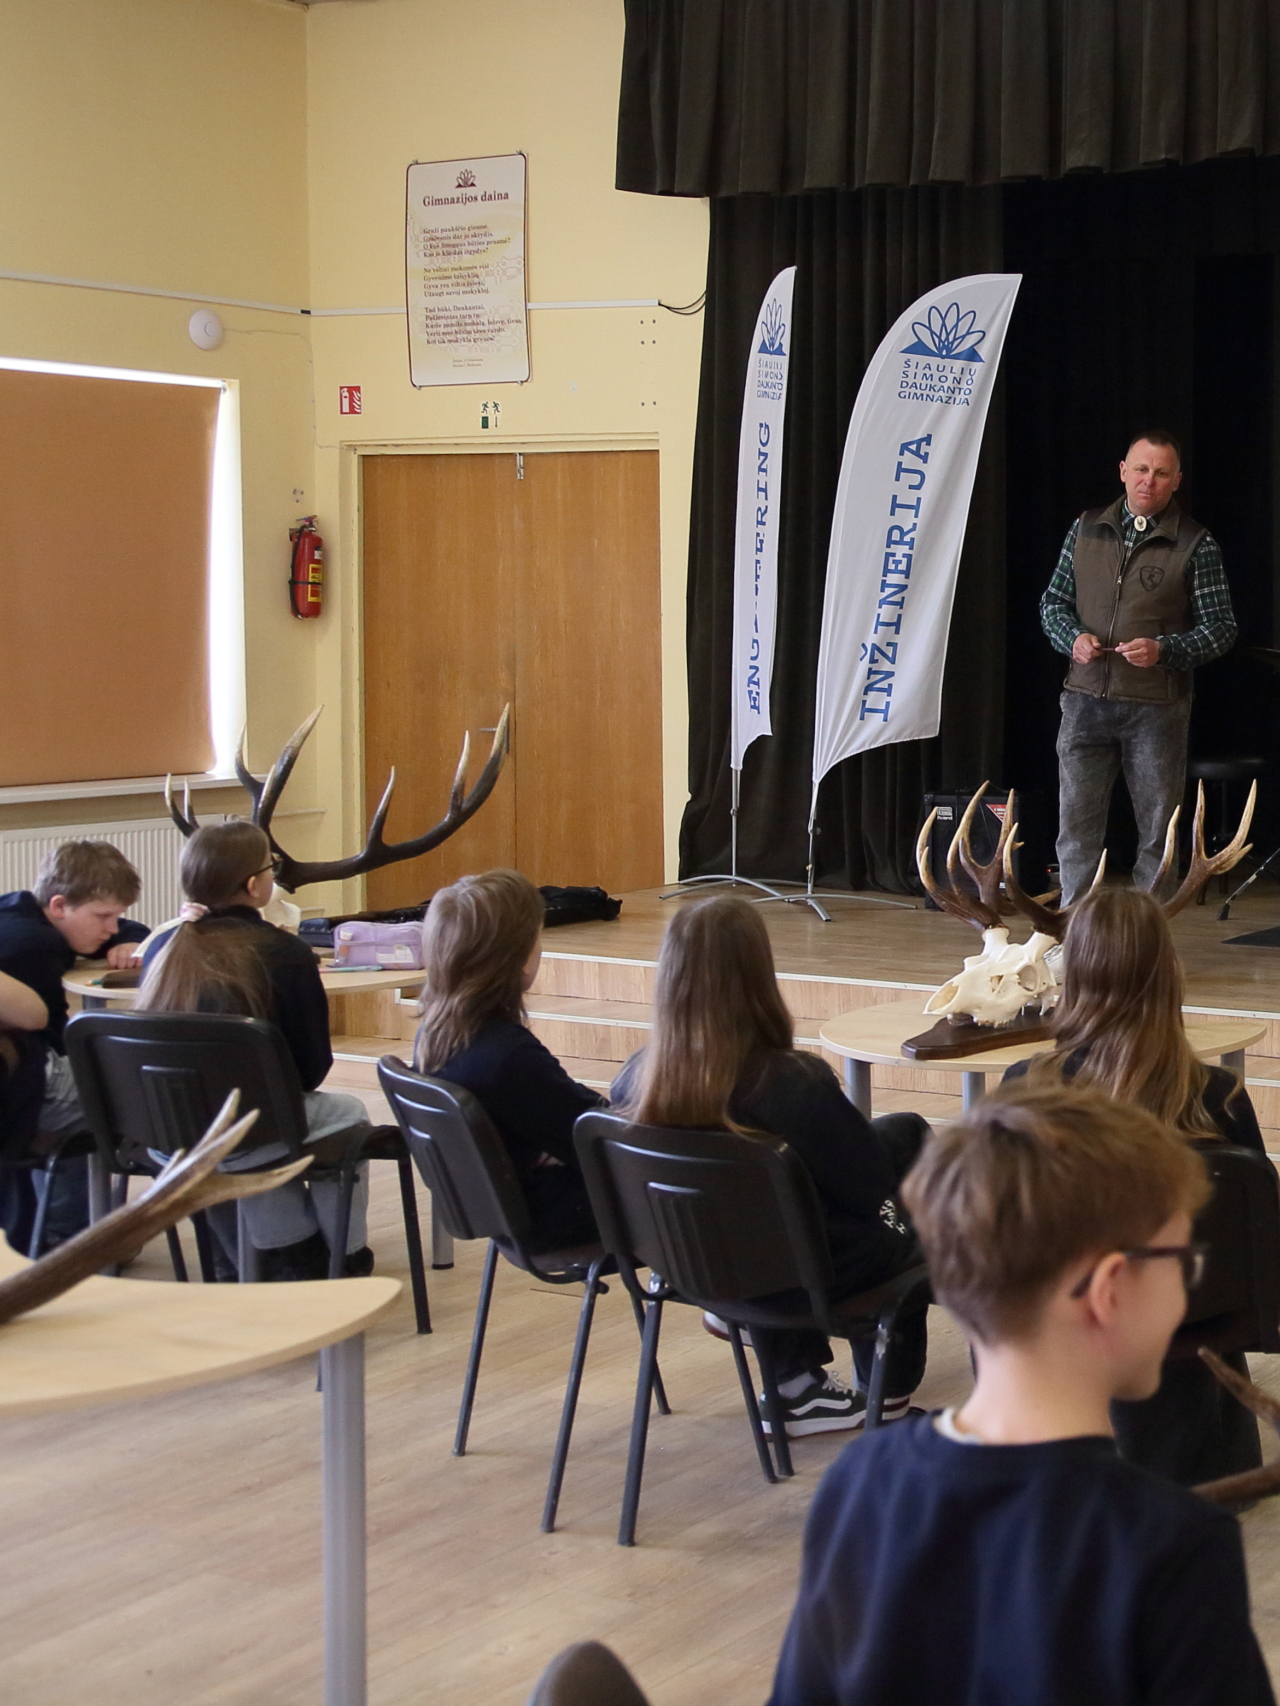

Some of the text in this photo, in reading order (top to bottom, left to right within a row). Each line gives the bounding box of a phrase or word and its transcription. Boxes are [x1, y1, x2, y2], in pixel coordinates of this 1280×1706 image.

[423, 190, 509, 207] Gimnazijos daina
[903, 358, 977, 378] ŠIAULIŲ
[901, 370, 974, 386] SIMONO
[899, 380, 972, 396] DAUKANTO
[898, 390, 970, 406] GIMNAZIJA
[747, 422, 771, 714] ENGEERING
[859, 433, 933, 723] INŽINERIJA
